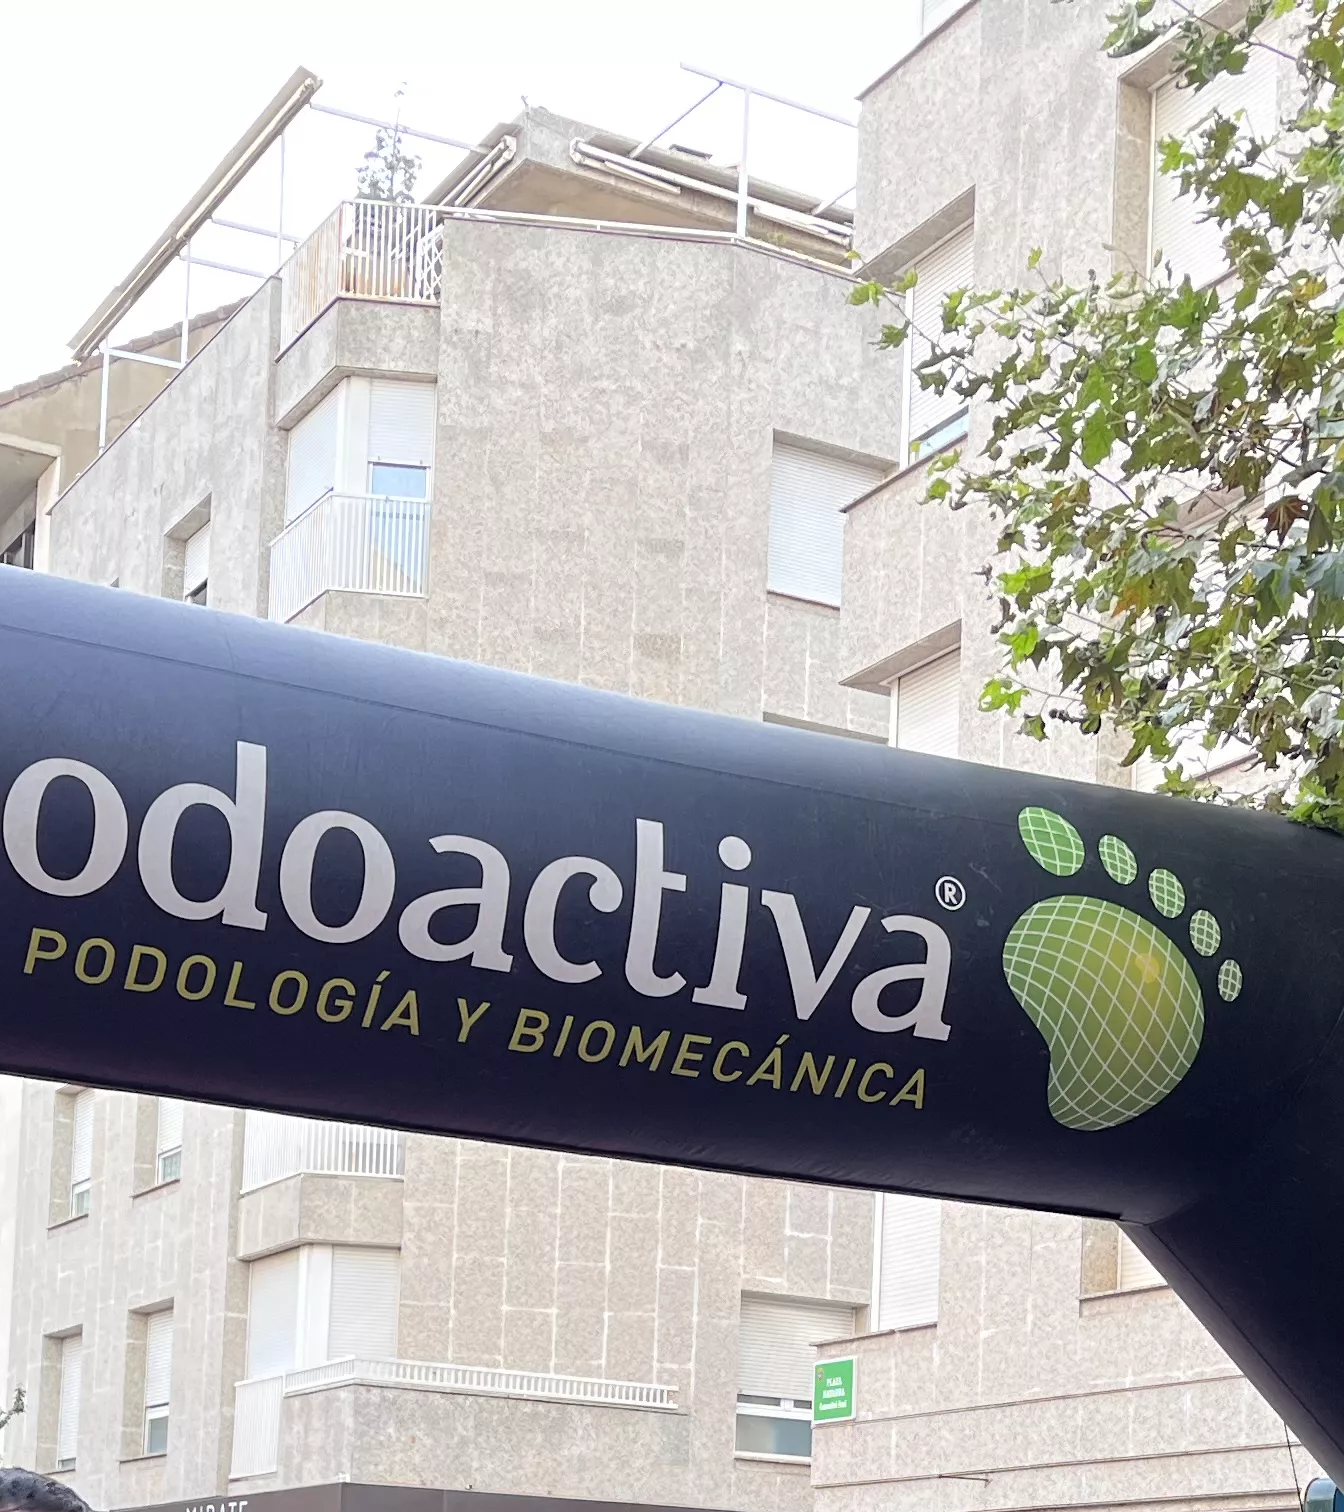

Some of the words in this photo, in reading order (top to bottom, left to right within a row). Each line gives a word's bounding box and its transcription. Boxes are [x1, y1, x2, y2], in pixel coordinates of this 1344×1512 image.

[23, 926, 421, 1037] PODOLOGÍA
[456, 997, 491, 1044] Y
[507, 1007, 928, 1111] BIOMECÁNICA
